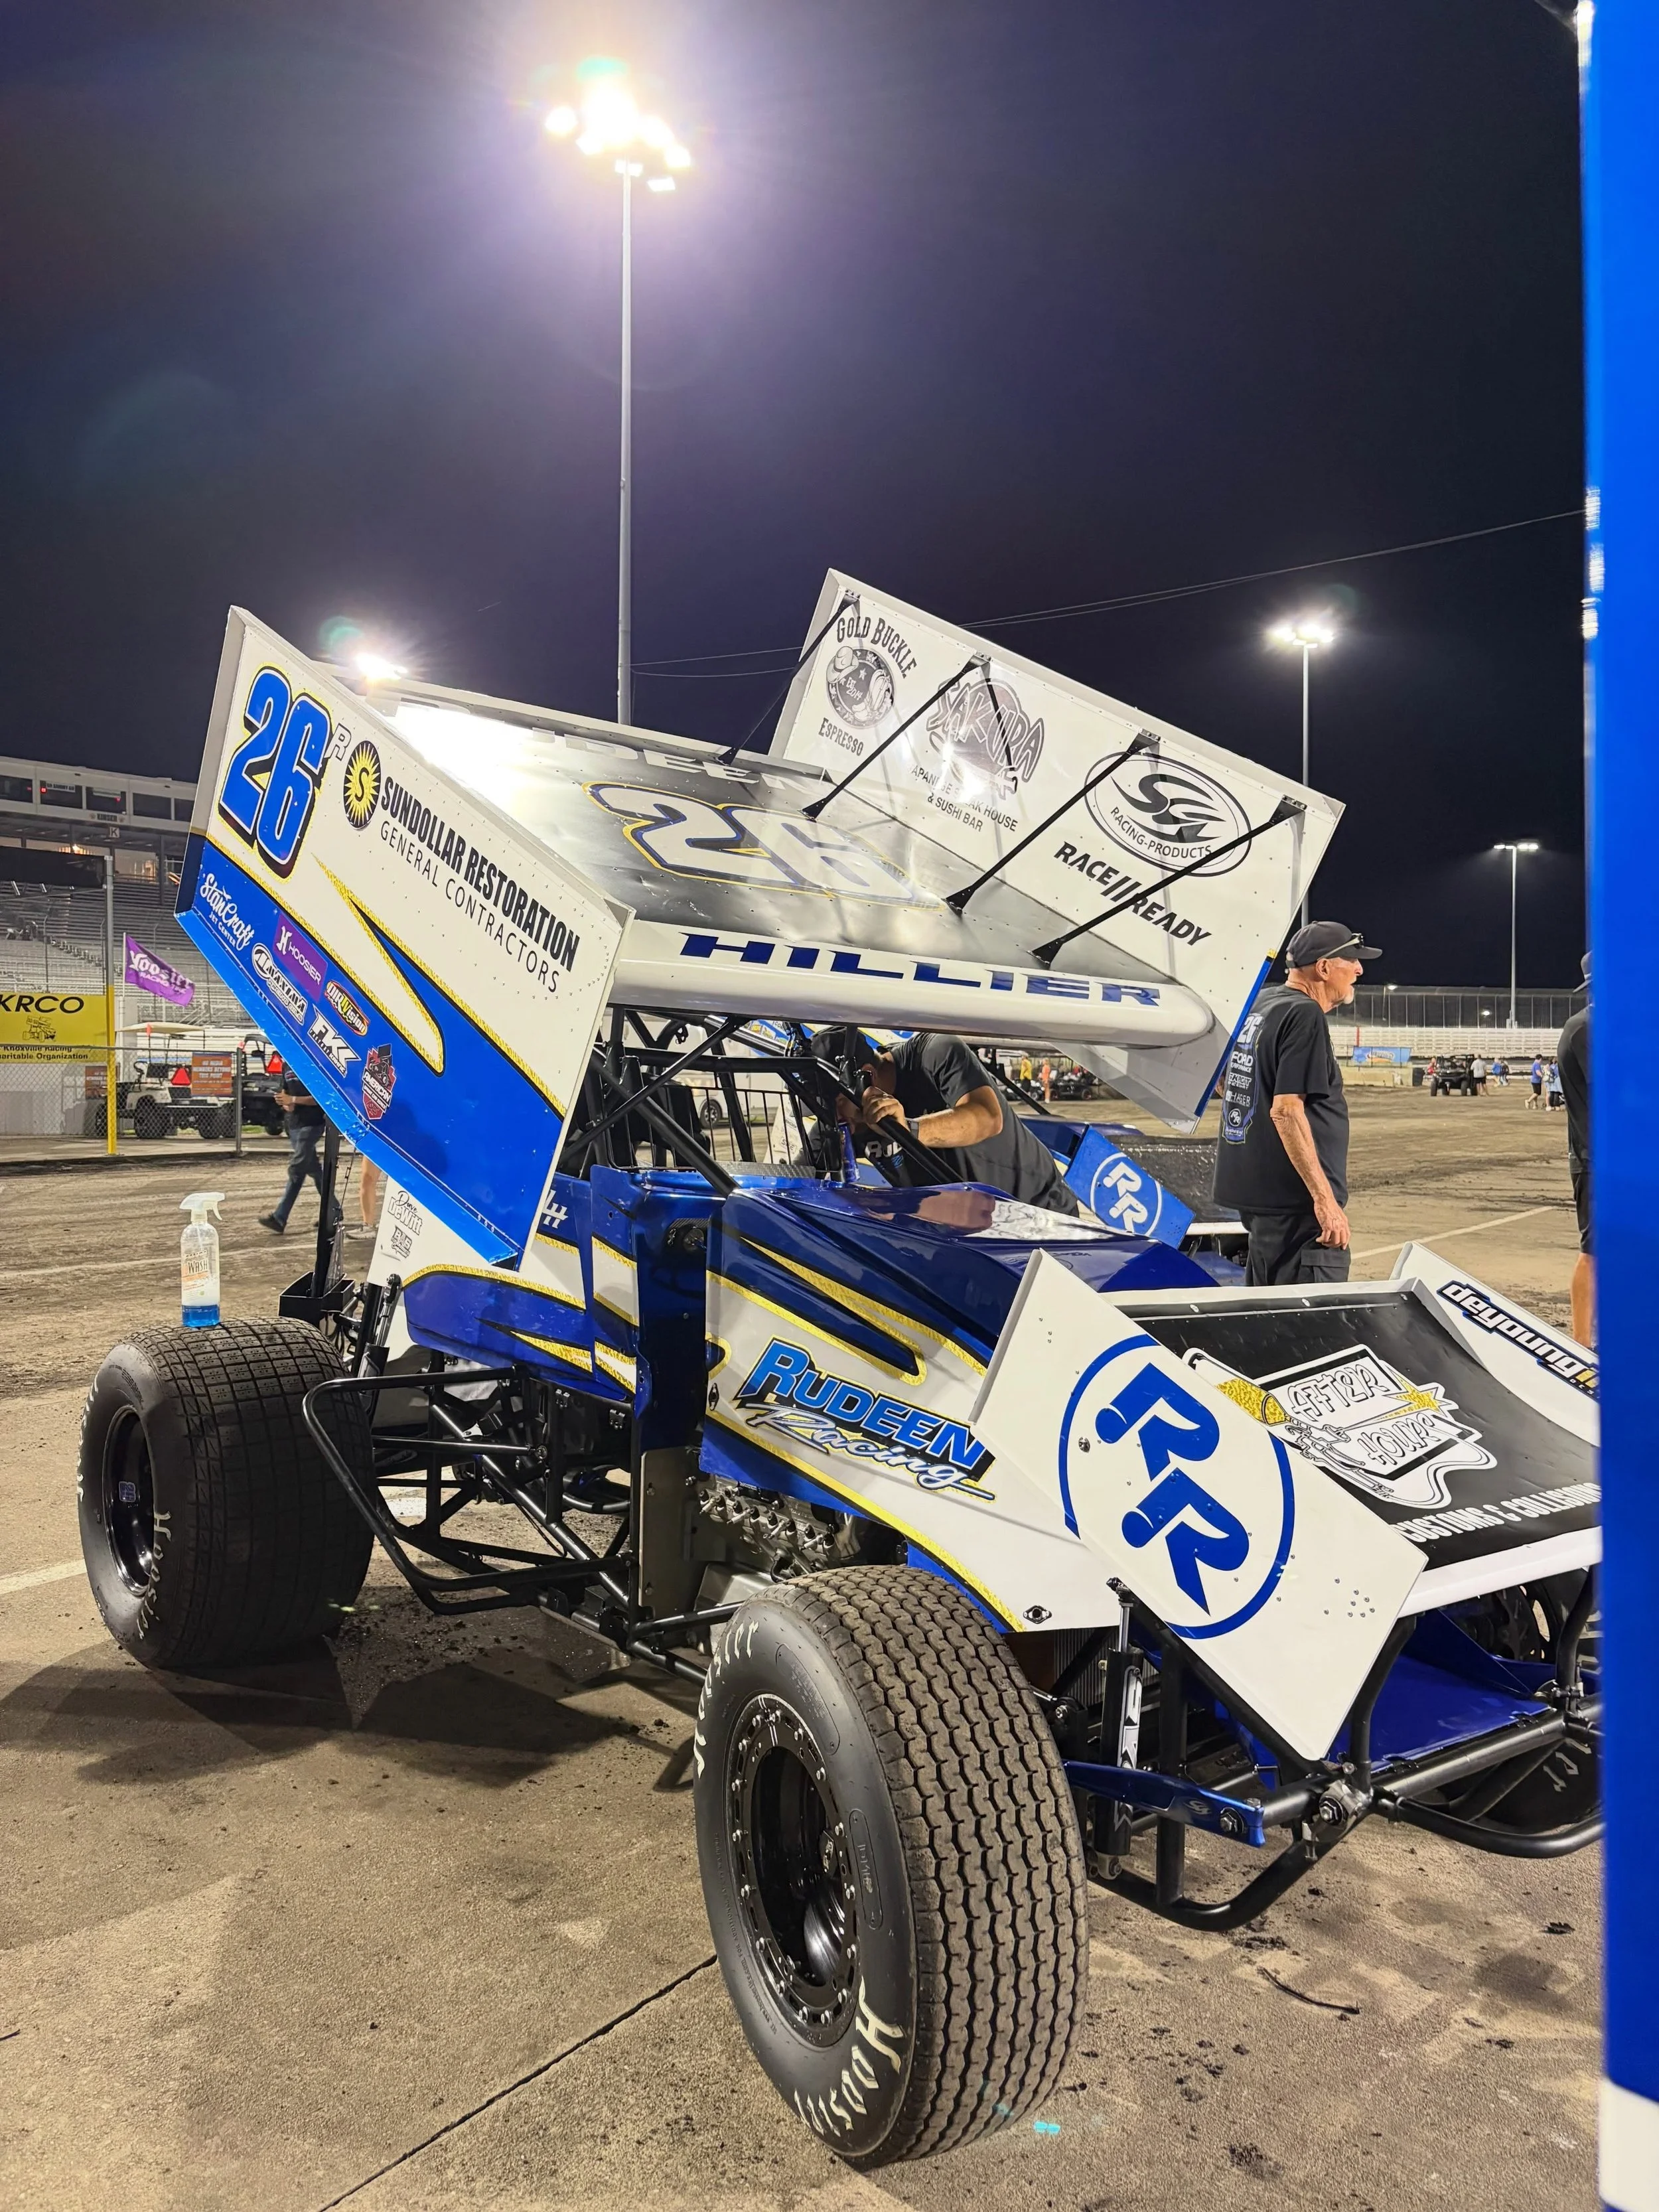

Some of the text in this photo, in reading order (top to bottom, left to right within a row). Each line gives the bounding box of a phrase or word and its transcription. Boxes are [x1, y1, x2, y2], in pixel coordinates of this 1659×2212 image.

[837, 616, 917, 679] GOLD BUCKLE
[818, 717, 864, 756] ESPRESSO
[926, 678, 1045, 782] SAKURA
[219, 666, 332, 875] 26
[110, 828, 118, 837] K
[927, 792, 983, 832] & SUSHI BAR
[983, 804, 1019, 832] HOUSE
[381, 776, 581, 973] SUNDOLLAR RESTORATION
[200, 873, 254, 950] StanCraft
[218, 922, 236, 948] CENTER
[381, 820, 560, 994] GENERAL CONTRACTORS
[264, 964, 307, 1015] MAXIMA
[288, 942, 322, 985] HOOSIER
[680, 932, 1160, 1007] HILLIER
[0, 994, 84, 1014] KRCO
[364, 1070, 392, 1102] AMERICAN
[736, 1338, 995, 1482] RUDEEN
[1287, 1364, 1390, 1422] AFTER
[745, 1402, 995, 1501] Racing
[1096, 1362, 1250, 1616] RR
[1391, 1507, 1505, 1542] CUSTOMS
[1482, 1504, 1522, 1522] &
